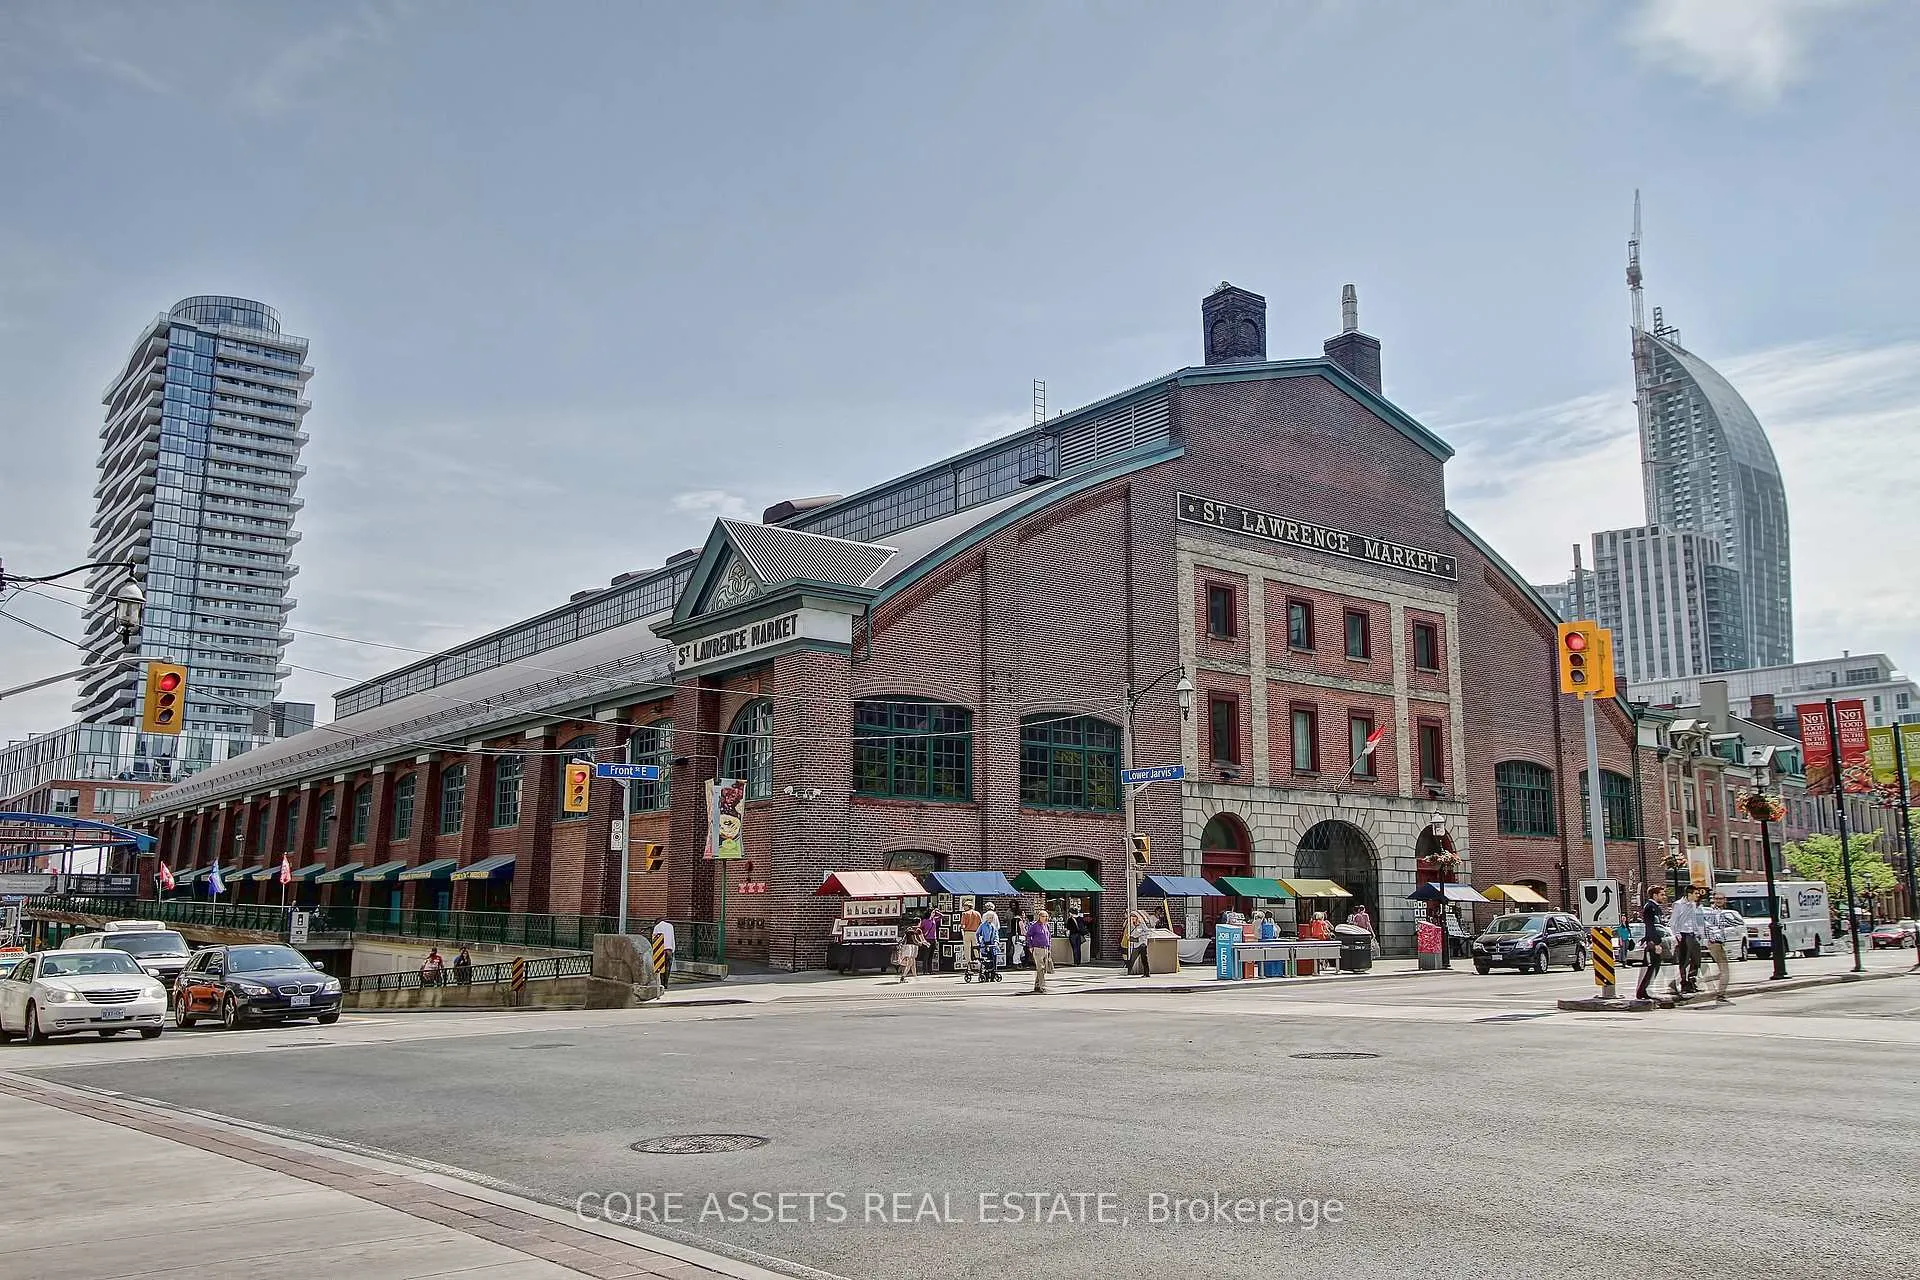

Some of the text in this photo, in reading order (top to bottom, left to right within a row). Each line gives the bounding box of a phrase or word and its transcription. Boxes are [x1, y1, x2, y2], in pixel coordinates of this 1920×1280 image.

[1241, 510, 1350, 552] LAWRENCE
[1364, 538, 1439, 573] MARKET
[693, 629, 747, 662] LAWRENCE
[751, 613, 798, 647] MARKET
[1803, 724, 1826, 732] FOOD
[1839, 720, 1864, 728] FOOD
[610, 765, 633, 775] Front
[641, 766, 647, 776] E
[1128, 771, 1150, 780] Lower
[1150, 768, 1172, 779] Jarvis
[1220, 947, 1228, 975] FREE
